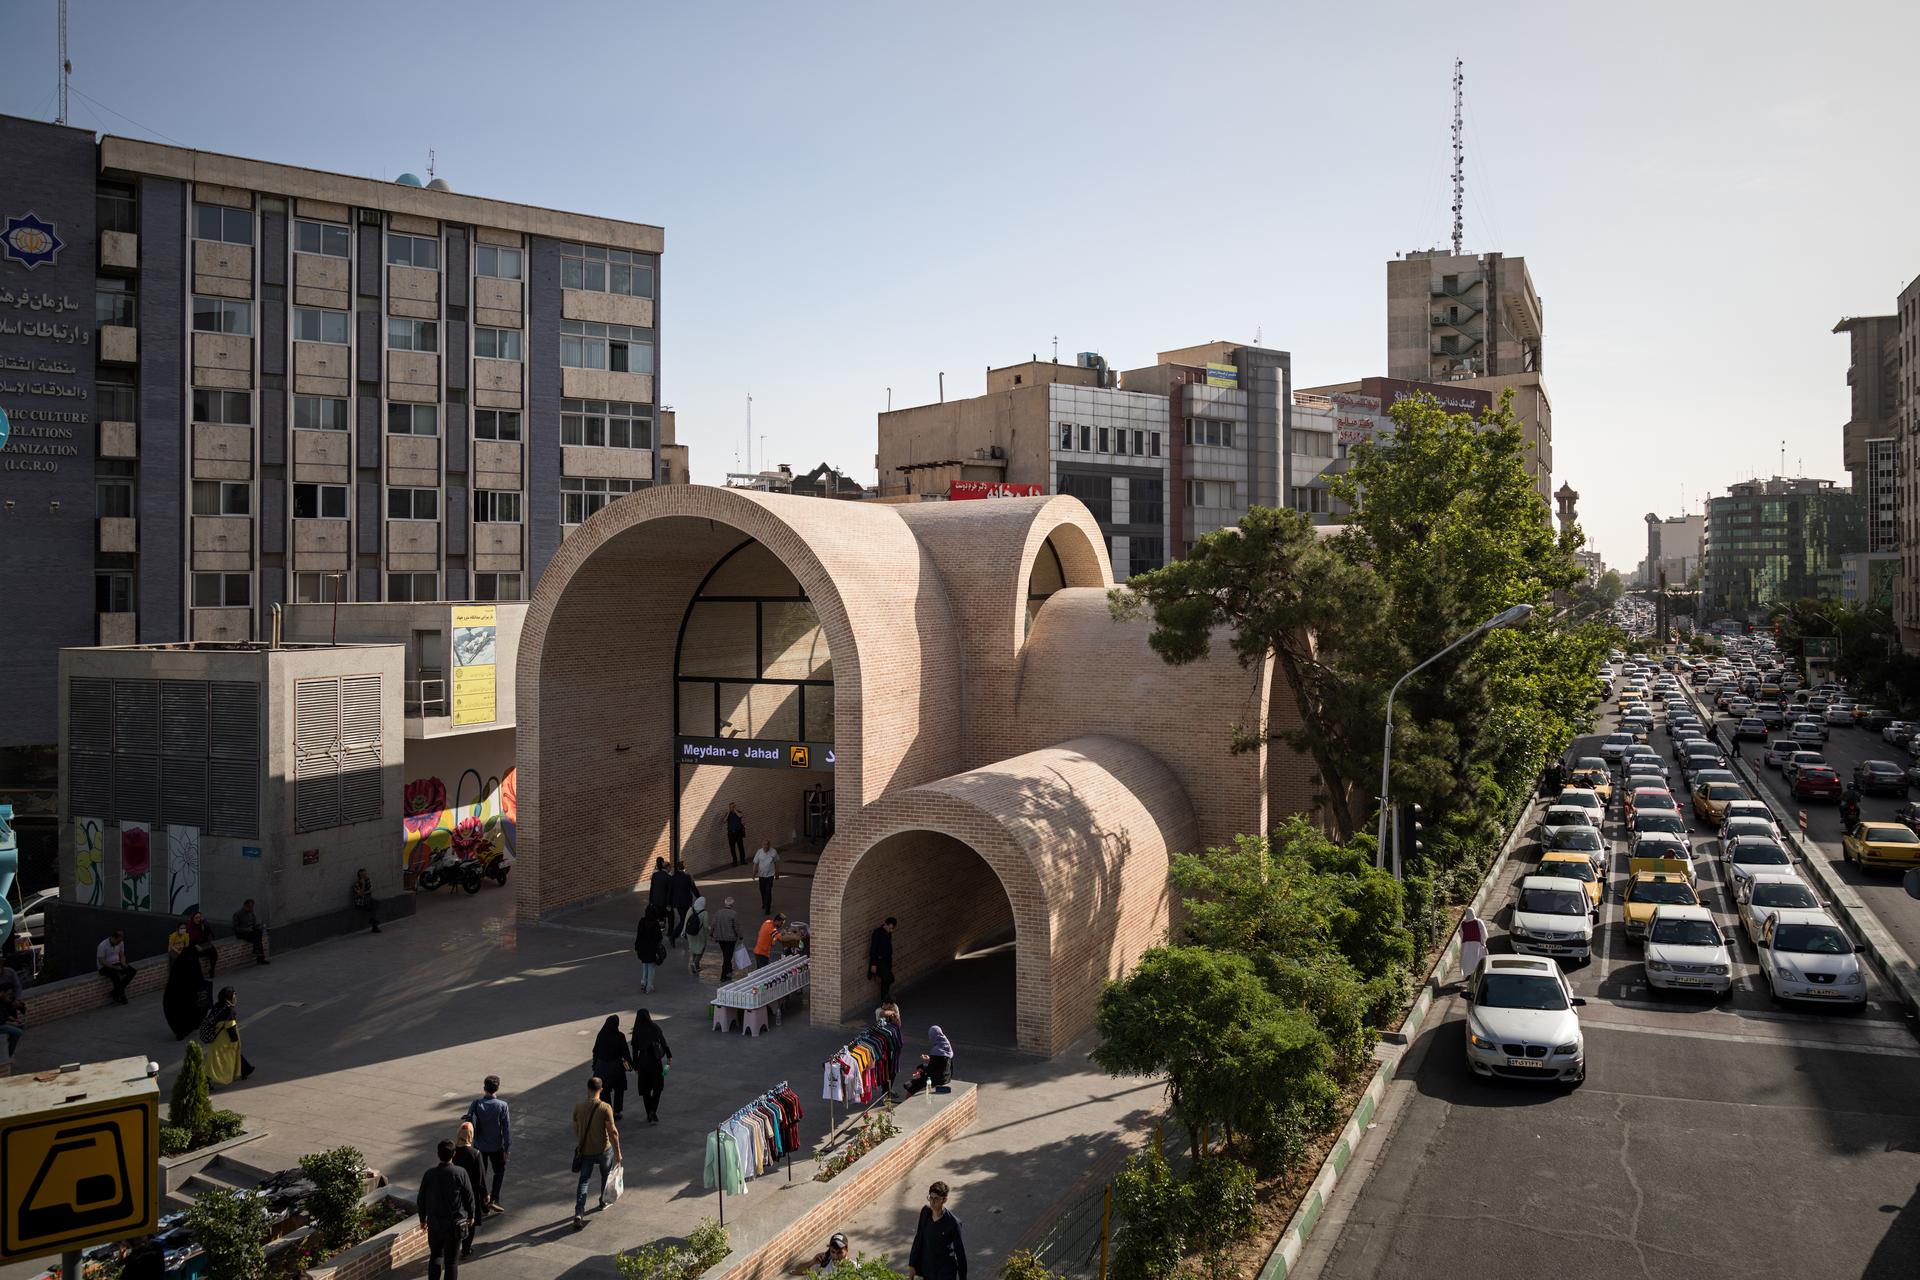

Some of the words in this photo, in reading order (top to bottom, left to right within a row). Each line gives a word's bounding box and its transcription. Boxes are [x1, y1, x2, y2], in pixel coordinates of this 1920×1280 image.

[29, 292, 79, 313] سازمان
[23, 320, 79, 345] ارتباطات
[38, 356, 76, 375] منظمة
[30, 410, 89, 424] CULTURE
[5, 459, 59, 473] (I.C.R.O)
[683, 743, 740, 759] Meydan-e
[744, 746, 780, 760] Jahad
